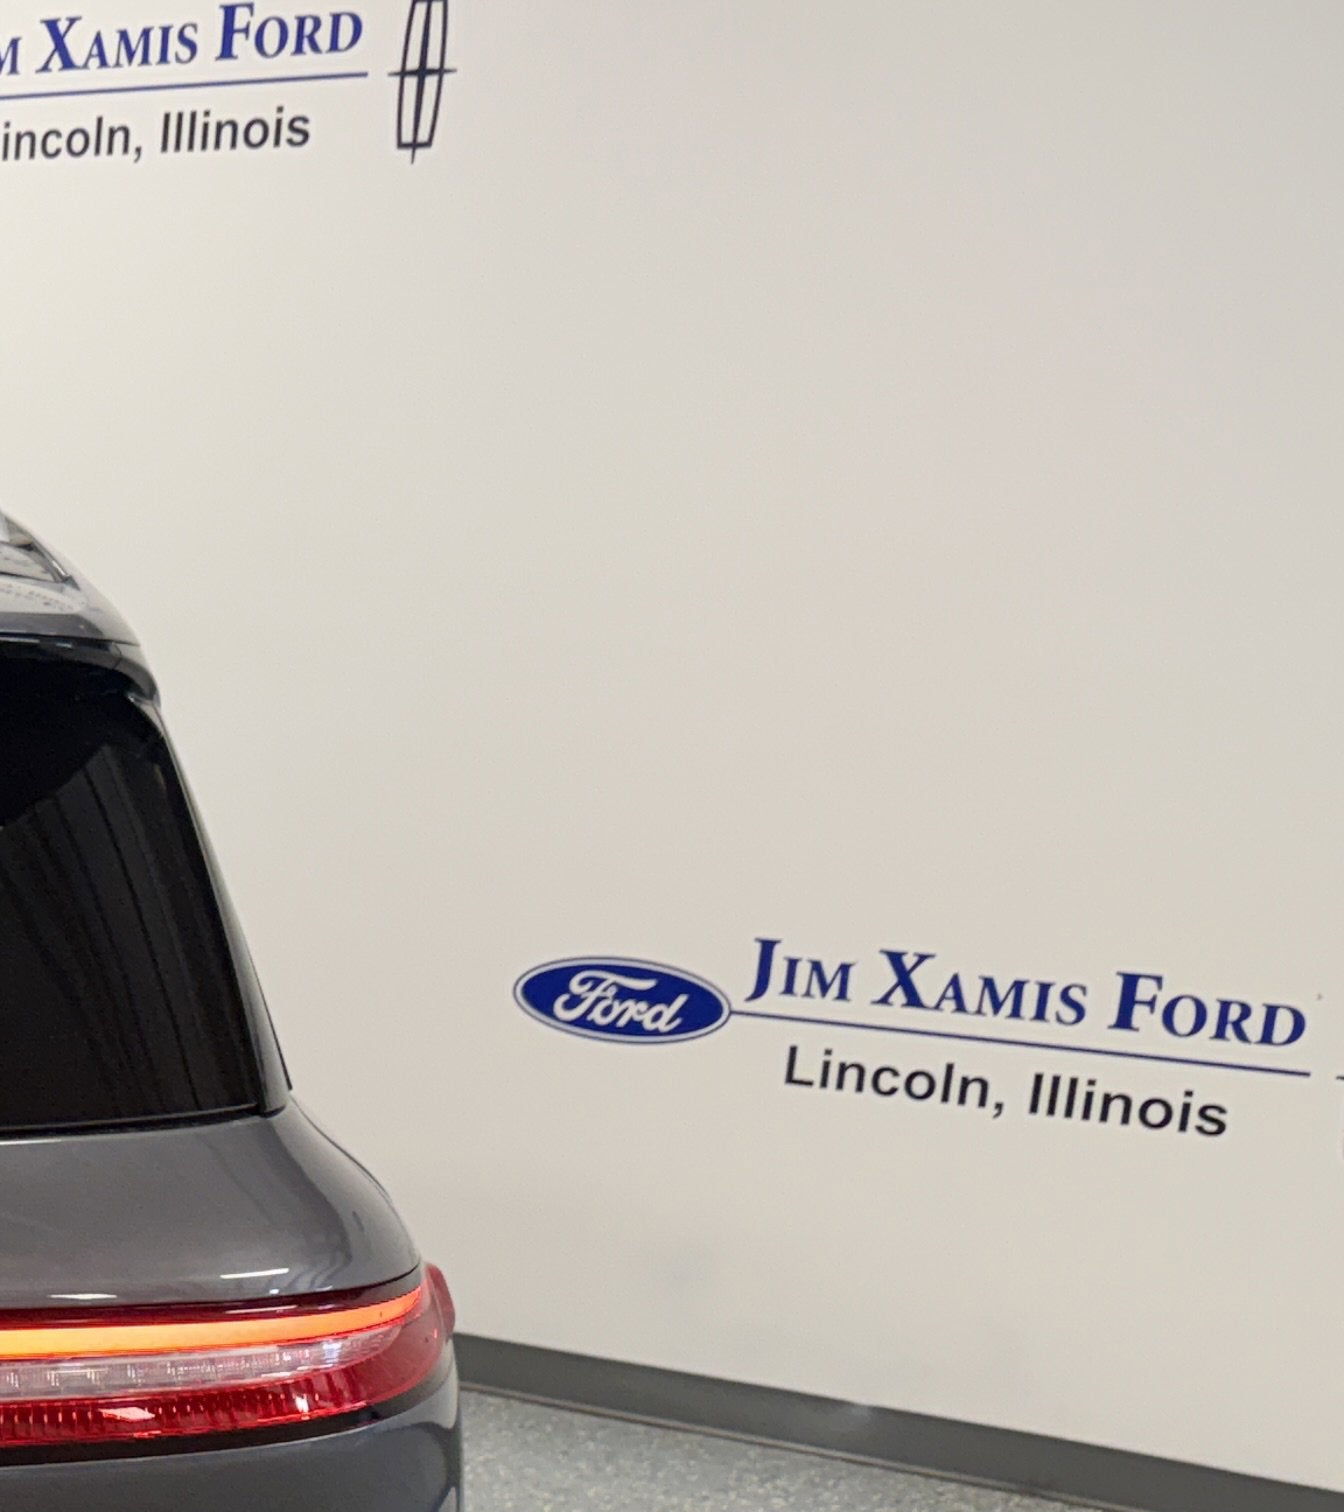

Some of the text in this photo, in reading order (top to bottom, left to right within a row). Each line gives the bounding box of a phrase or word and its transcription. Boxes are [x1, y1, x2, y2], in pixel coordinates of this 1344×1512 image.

[36, 16, 197, 73] XAMIS
[215, 2, 362, 61] FORD
[161, 106, 310, 153] Illinois
[553, 969, 688, 1035] Ford
[744, 938, 1306, 1046] JIM XAMIS FORD
[785, 1045, 1227, 1137] Lincoln, Illinois
